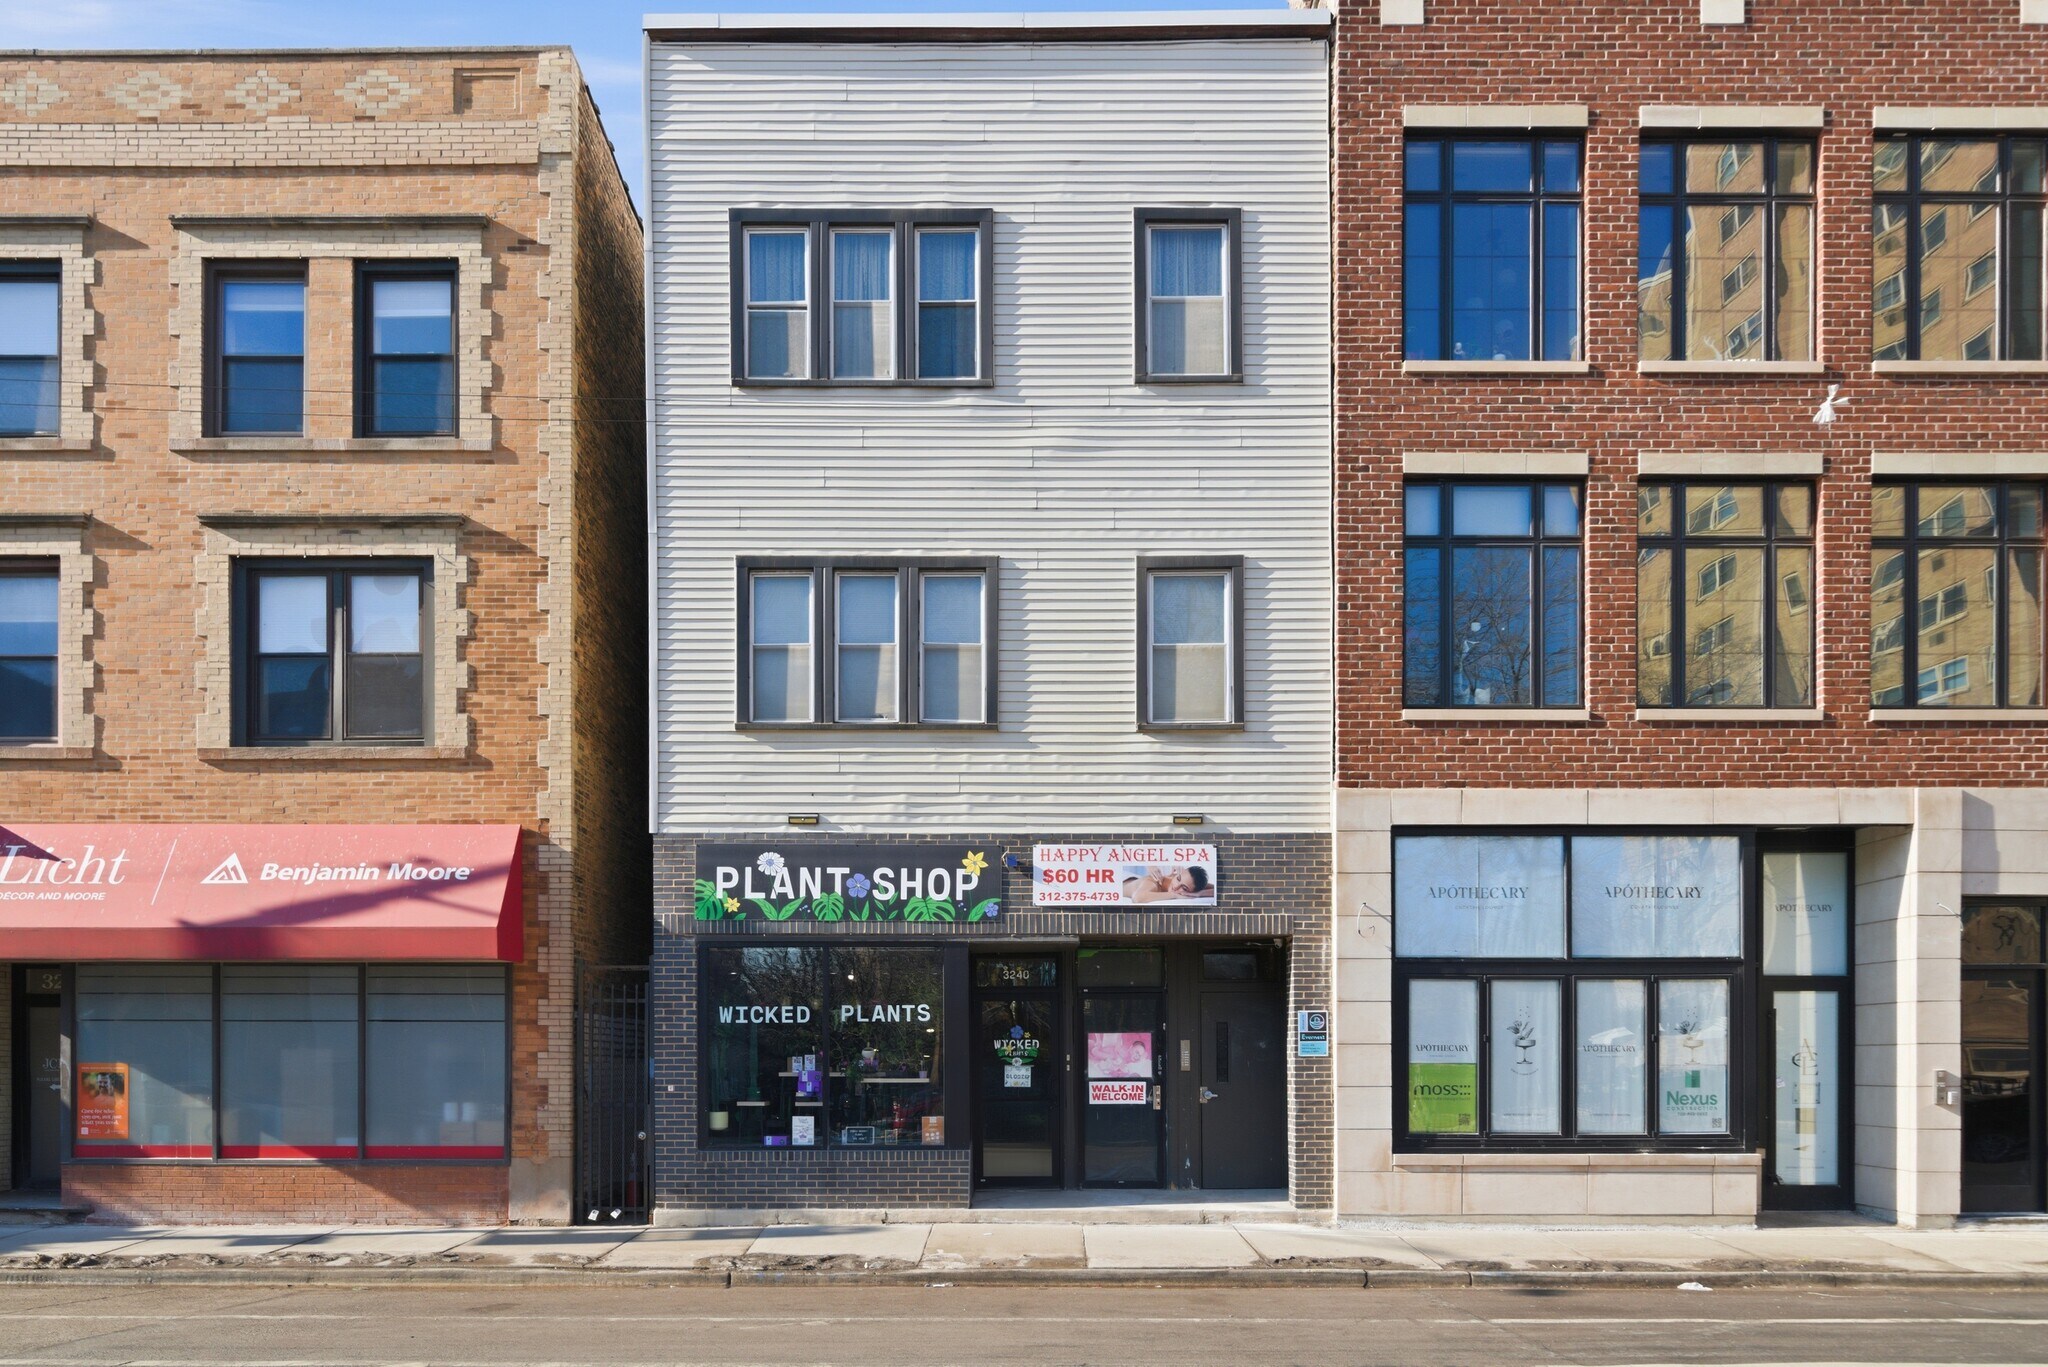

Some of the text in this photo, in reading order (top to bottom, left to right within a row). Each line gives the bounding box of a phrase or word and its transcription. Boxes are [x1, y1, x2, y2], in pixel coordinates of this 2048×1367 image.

[1040, 846, 1210, 862] HAPPY ANGEL SPA
[0, 845, 130, 885] Licht
[260, 862, 471, 884] Benjamin Moore
[715, 866, 979, 900] PLANT SHOP
[1043, 868, 1115, 884] $60 HR
[37, 892, 62, 900] AND
[63, 892, 106, 900] MOORE
[1039, 892, 1120, 902] 312-375-4739
[1003, 970, 1030, 980] 3240
[719, 1004, 931, 1024] WICKED PLANTS
[993, 1039, 1040, 1050] WICKED
[1091, 1085, 1144, 1093] WALK-IN
[1092, 1092, 1144, 1101] WELCOME
[1666, 1090, 1718, 1106] Nexus
